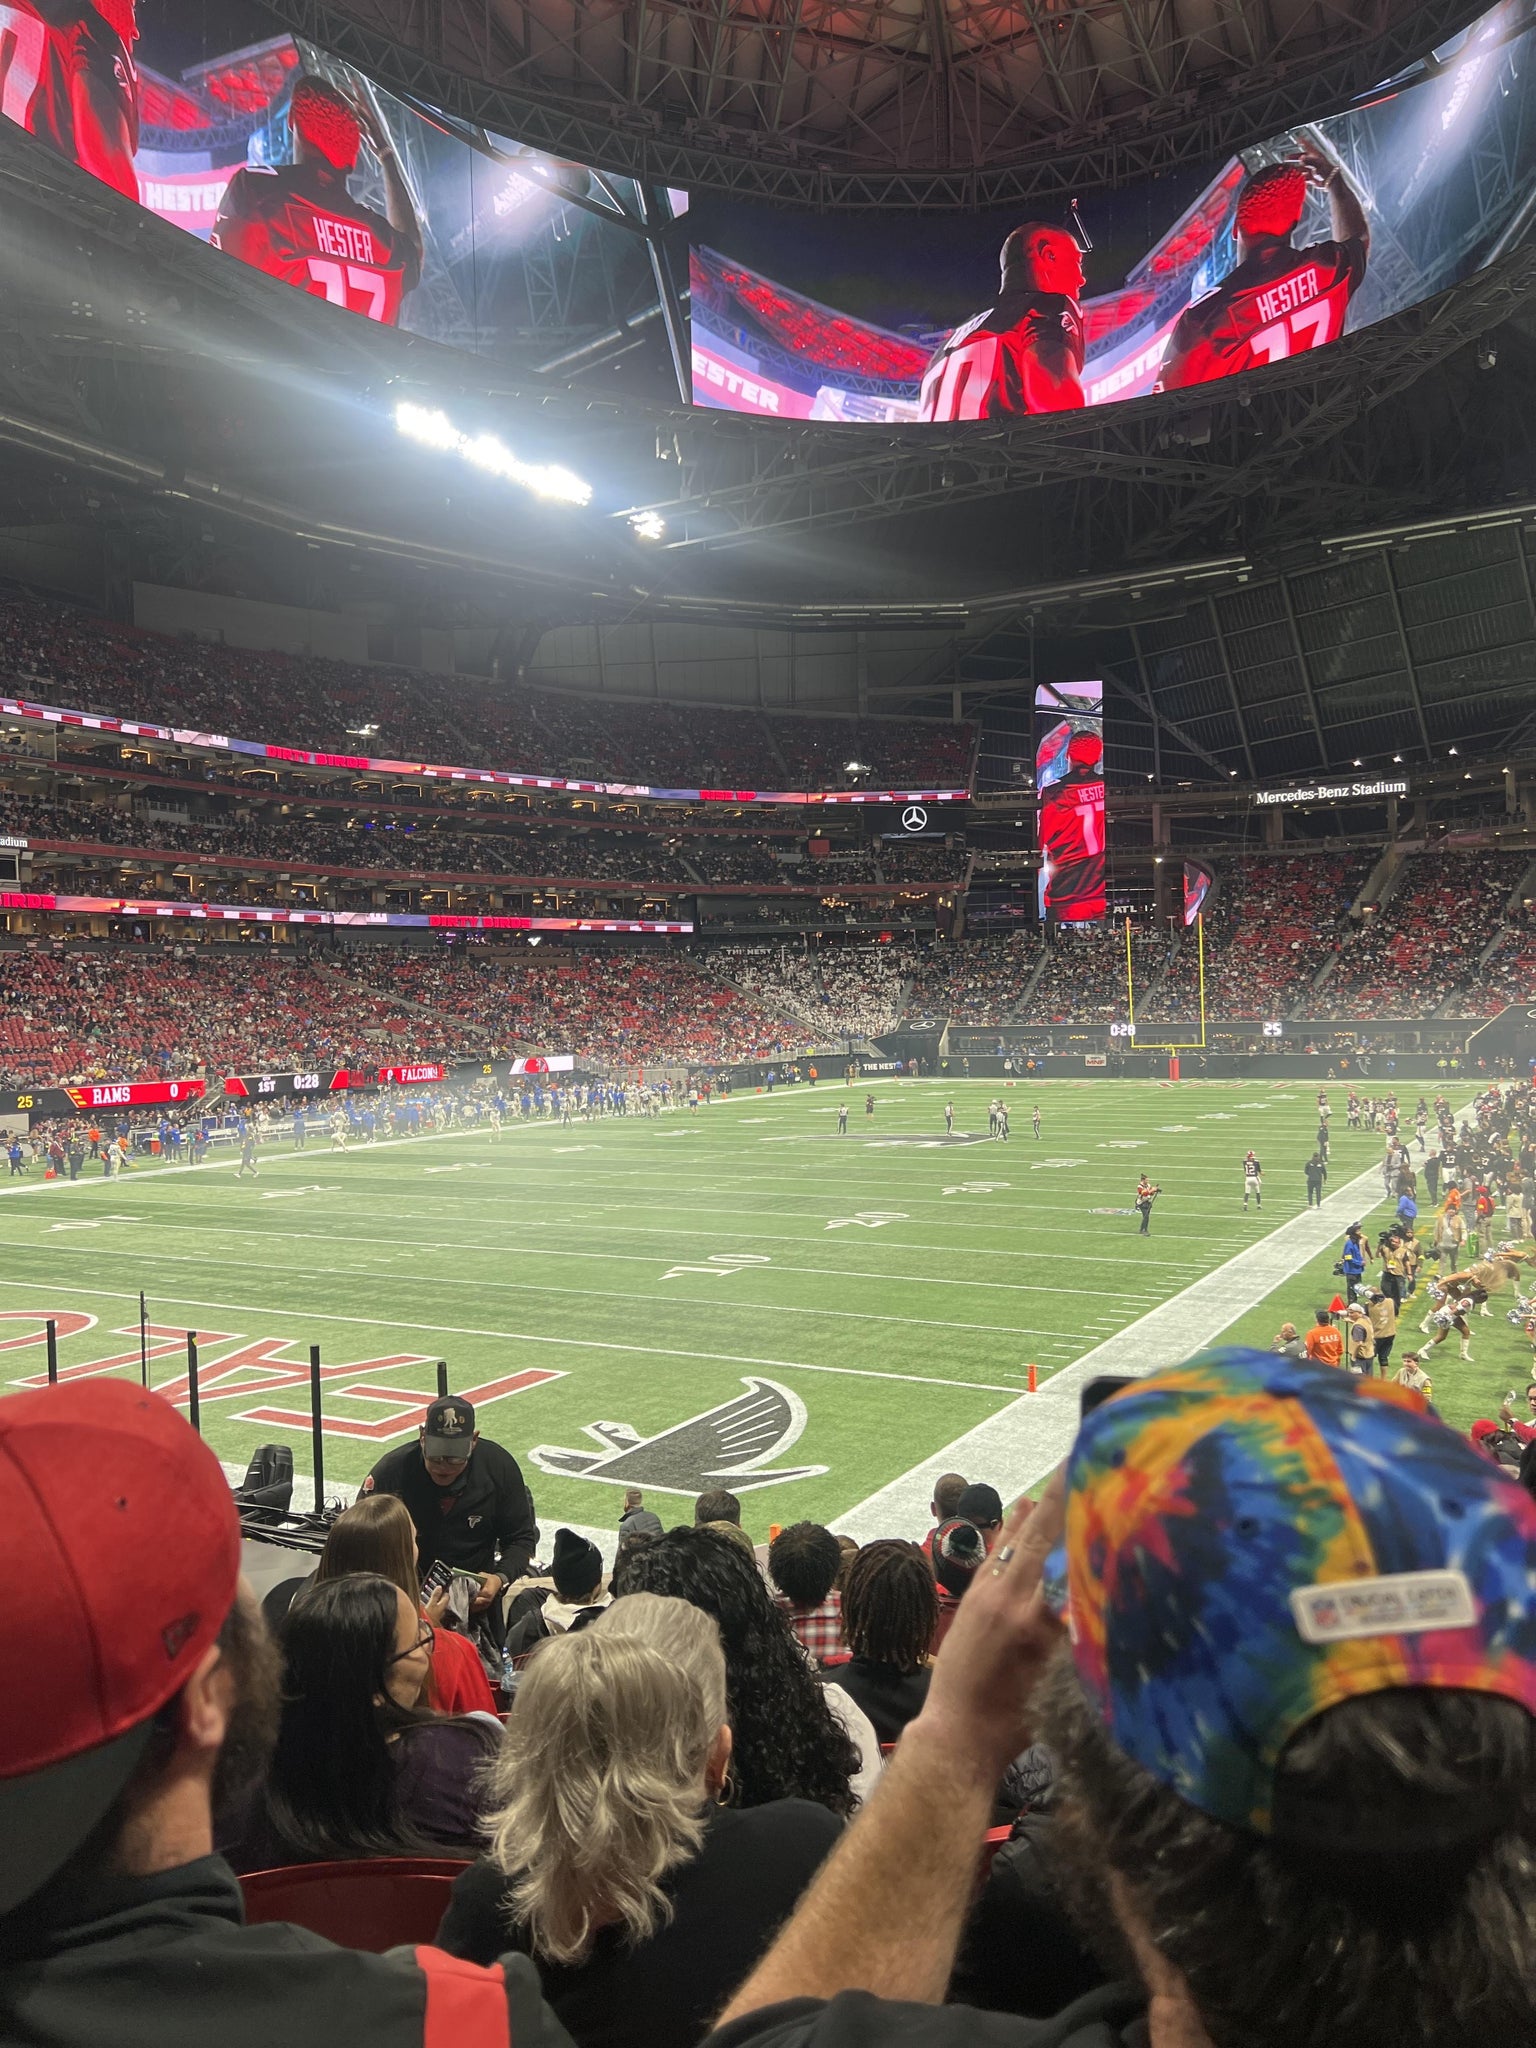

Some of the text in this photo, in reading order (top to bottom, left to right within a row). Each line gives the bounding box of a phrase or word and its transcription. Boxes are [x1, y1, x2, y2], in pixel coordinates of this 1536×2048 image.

[312, 216, 374, 264] HESTER
[1256, 268, 1318, 323] HESTER
[266, 744, 370, 770] DIRTY BIRDS
[1256, 781, 1407, 804] Mercedes-Benz Stadium
[0, 892, 56, 911] IRDS
[1113, 905, 1137, 914] ATL
[428, 915, 532, 929] DIRTY BIRDS
[1110, 1023, 1136, 1037] 0:28
[1263, 1023, 1282, 1037] 25
[482, 1064, 492, 1074] 25
[863, 1063, 879, 1071] THE
[258, 1080, 276, 1093] 1ST
[293, 1074, 319, 1090] 0:28
[93, 1087, 131, 1105] RAMS
[170, 1084, 179, 1098] 0
[17, 1095, 34, 1109] 25
[1244, 1164, 1256, 1175] 12
[665, 1254, 771, 1277] 10
